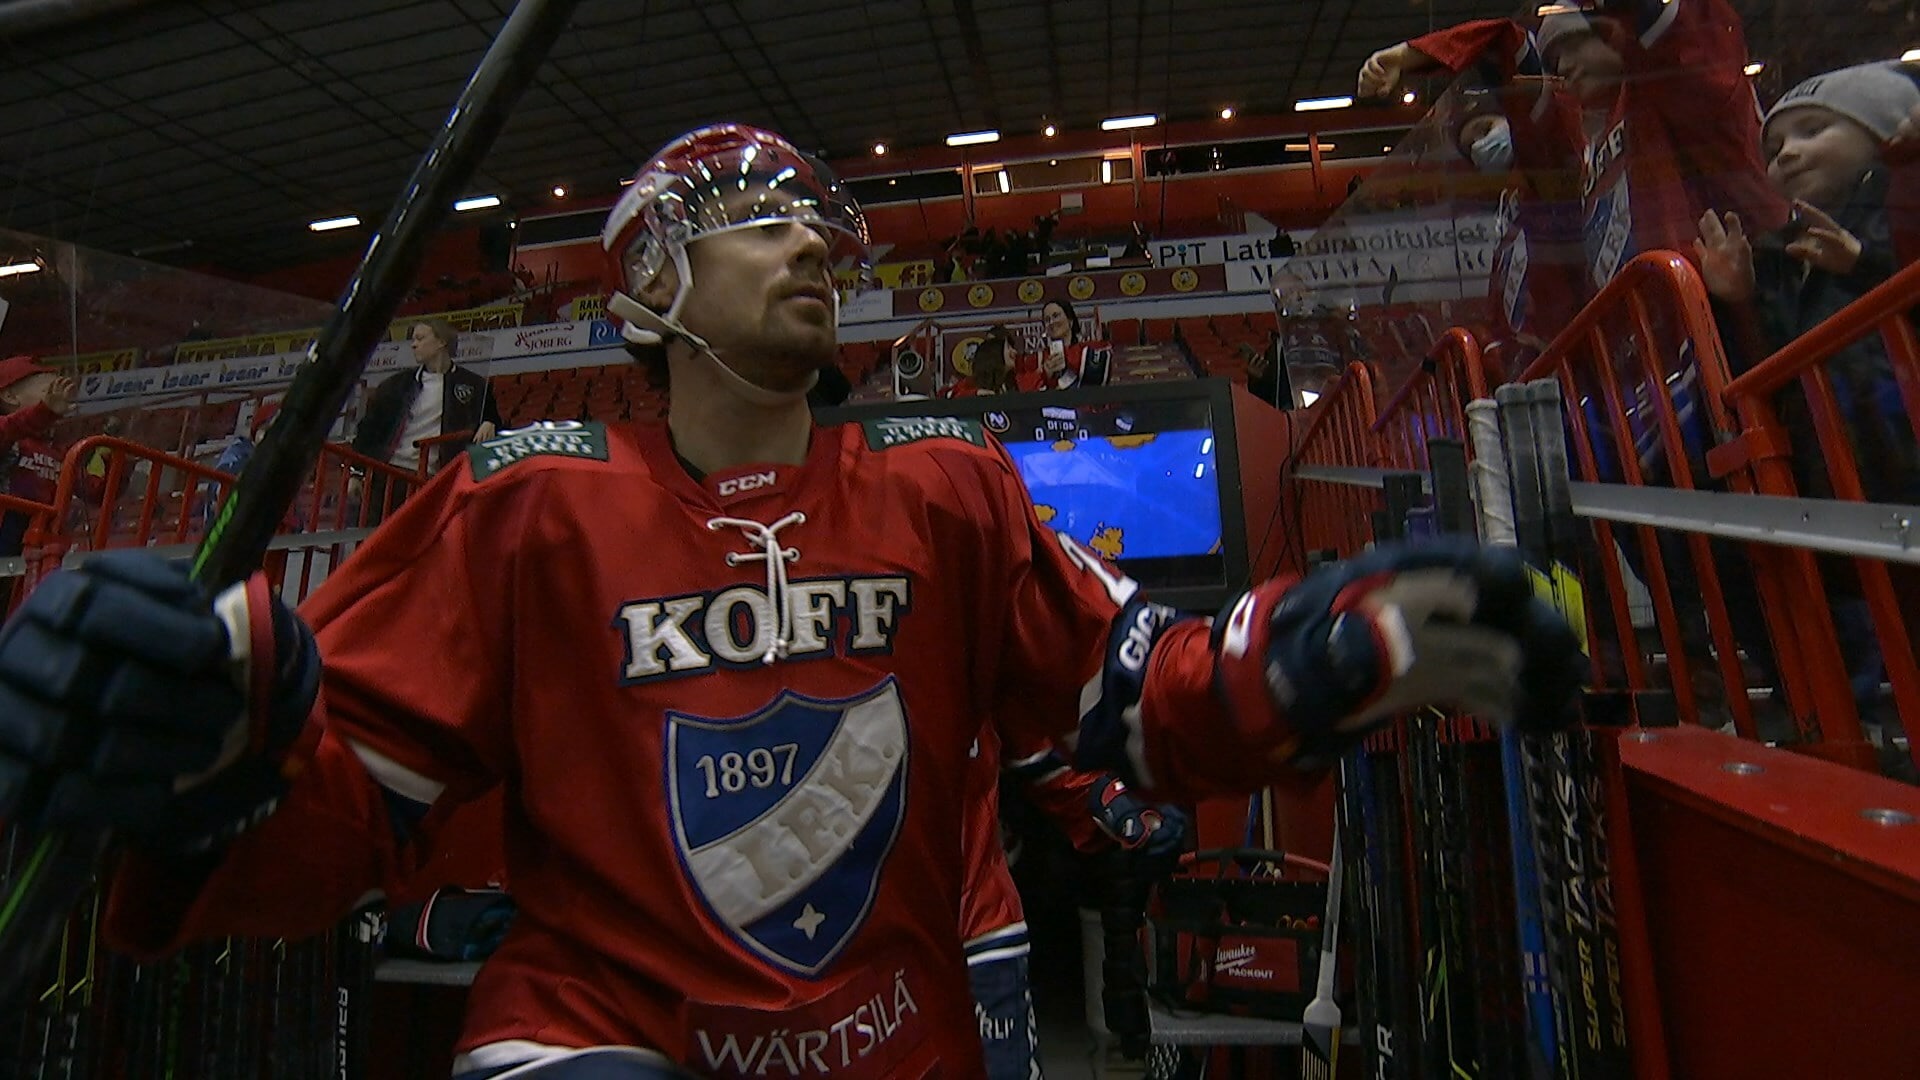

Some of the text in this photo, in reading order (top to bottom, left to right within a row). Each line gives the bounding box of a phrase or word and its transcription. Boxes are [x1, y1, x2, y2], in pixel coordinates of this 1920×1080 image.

[718, 470, 777, 497] CCM
[620, 577, 909, 681] KOFF
[695, 741, 800, 800] 1897
[1554, 769, 1594, 934] TACKS
[1228, 967, 1275, 979] PACKOUT
[696, 968, 918, 1077] WÄRTSILÄ
